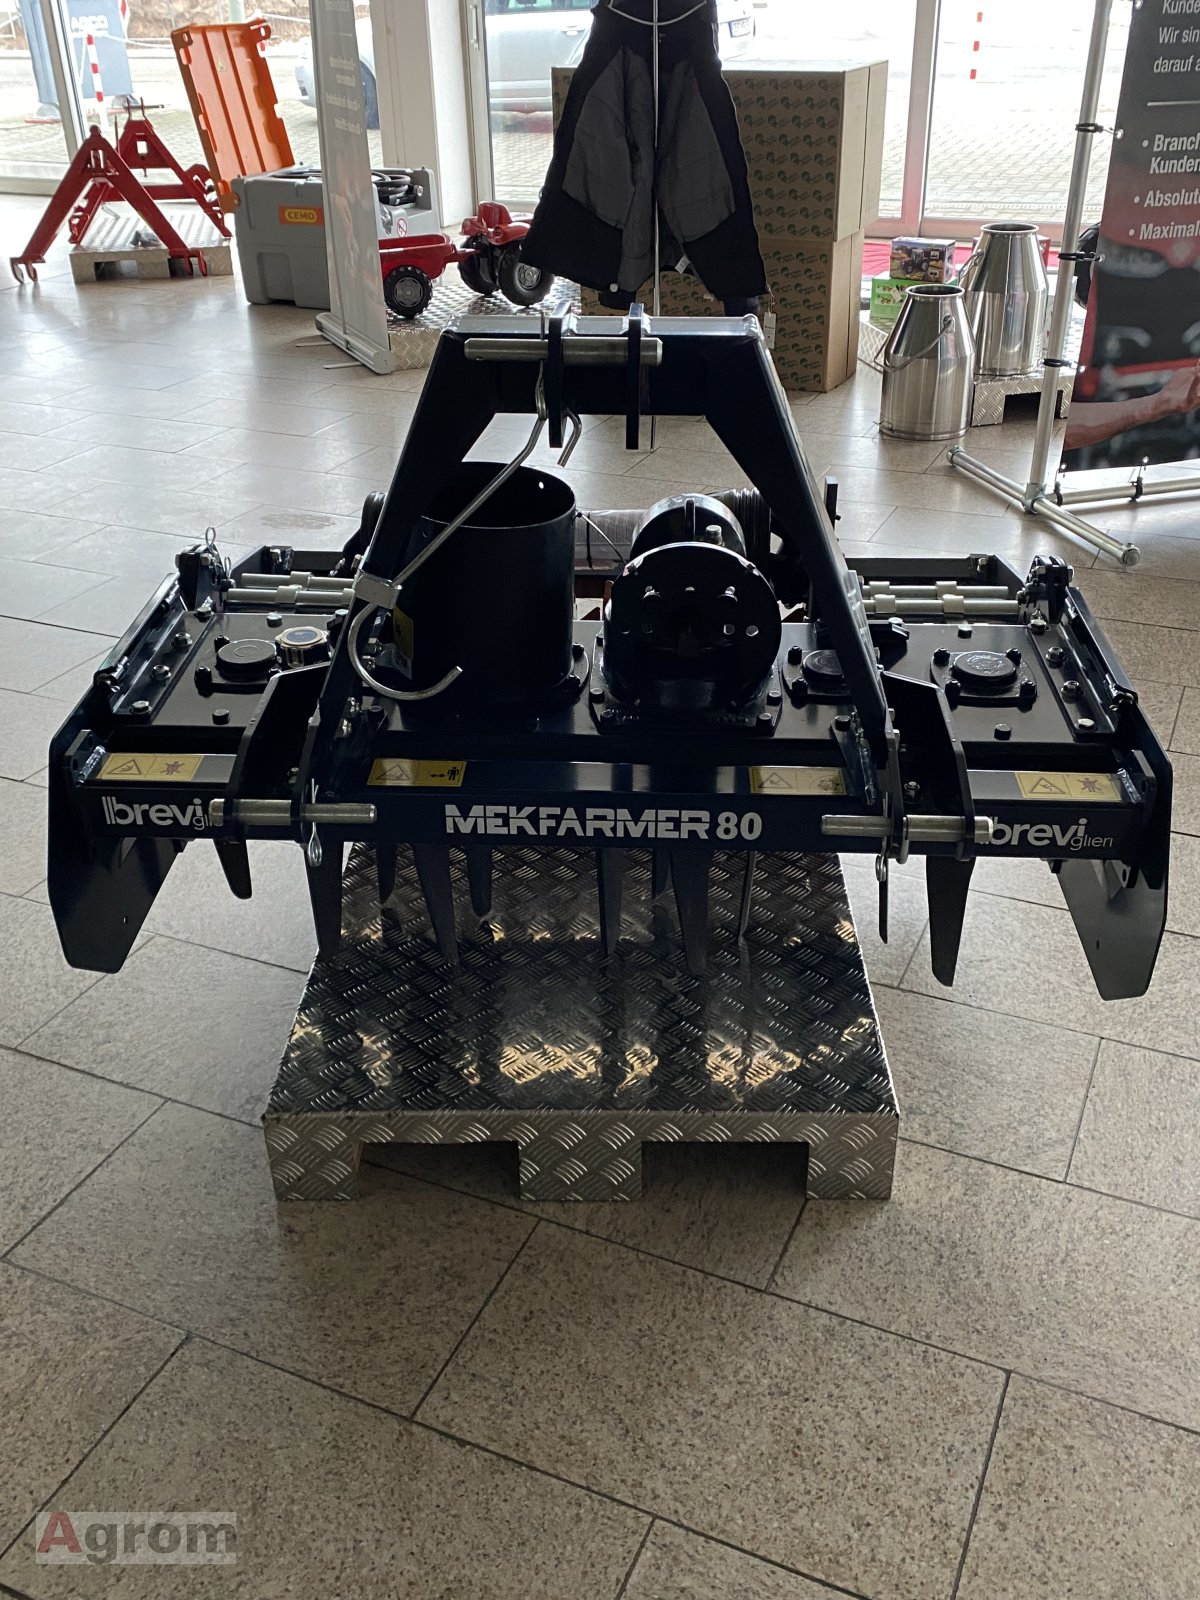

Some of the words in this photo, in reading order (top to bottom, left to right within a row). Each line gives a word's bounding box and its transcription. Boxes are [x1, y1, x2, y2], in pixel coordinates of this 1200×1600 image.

[1158, 26, 1180, 44] Wir
[1153, 54, 1194, 73] darauf
[1144, 188, 1200, 207] Absolut
[287, 211, 315, 221] CEMO
[1139, 220, 1200, 240] Maximal
[444, 804, 710, 839] MEKFARMER
[716, 811, 763, 840] 80
